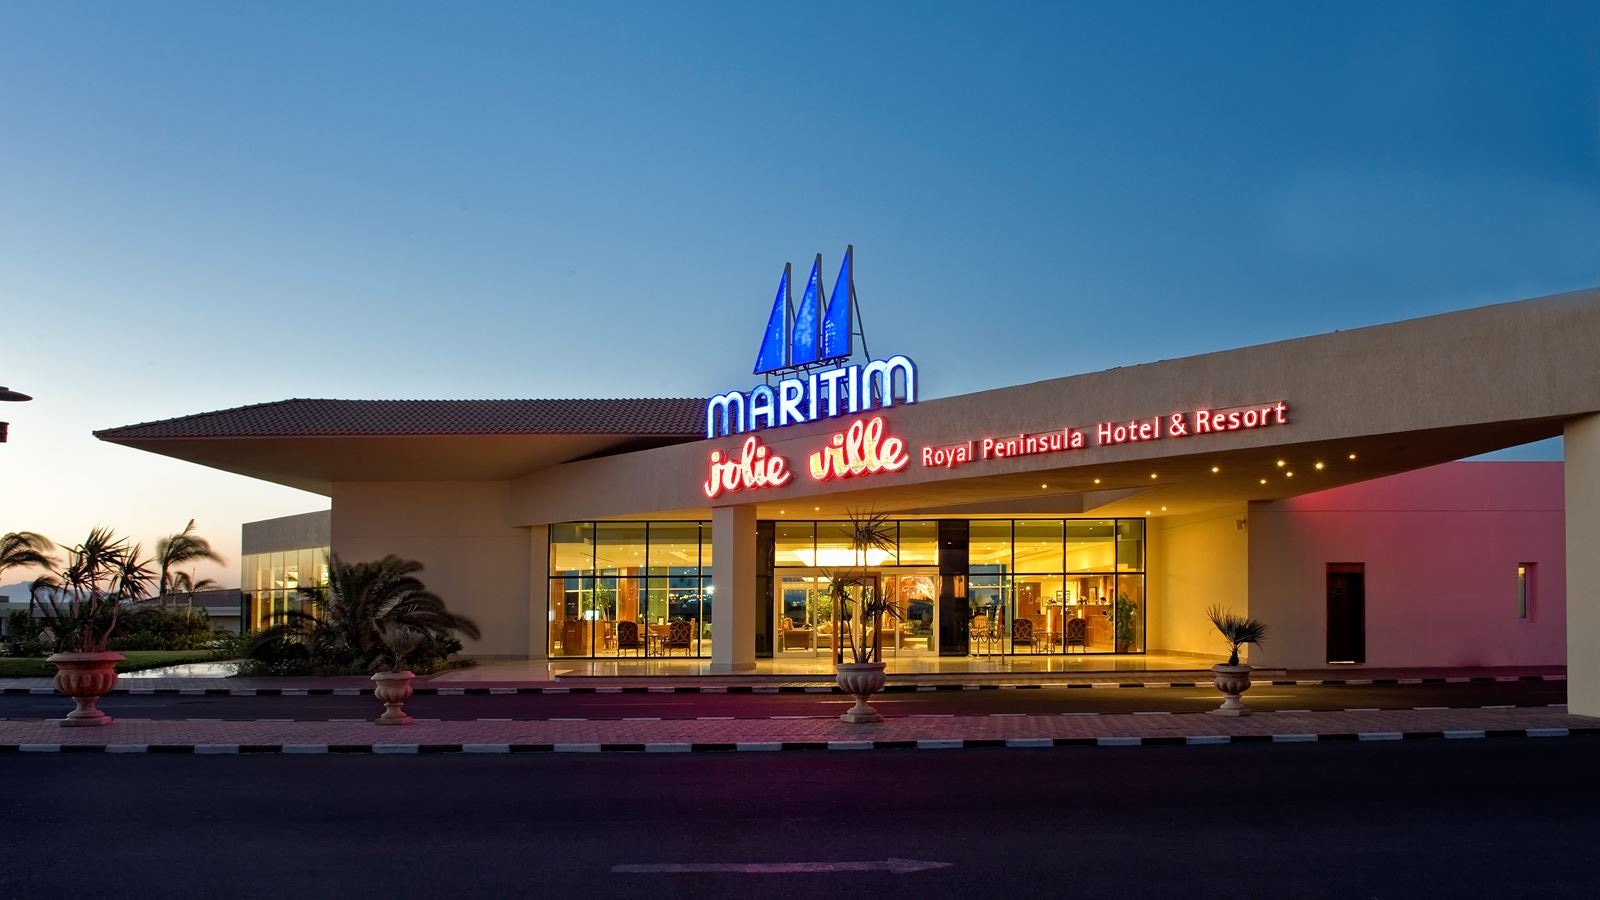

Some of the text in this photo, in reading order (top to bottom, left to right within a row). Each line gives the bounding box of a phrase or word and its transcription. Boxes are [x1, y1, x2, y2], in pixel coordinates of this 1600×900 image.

[706, 355, 917, 439] MARITIM
[922, 401, 1287, 468] Royal Peninsula Hotel & Resort
[705, 416, 909, 498] jolie ville
